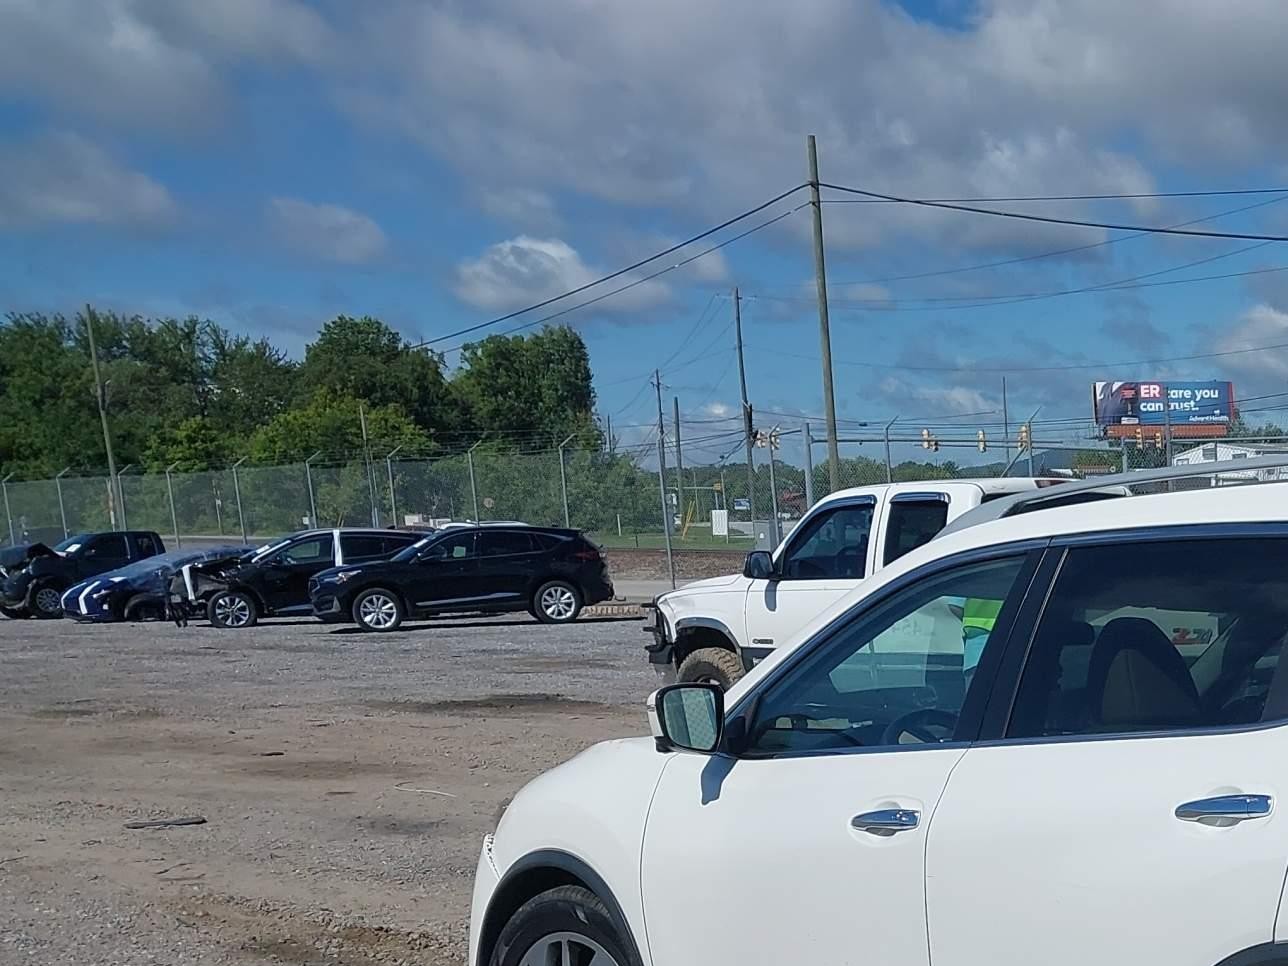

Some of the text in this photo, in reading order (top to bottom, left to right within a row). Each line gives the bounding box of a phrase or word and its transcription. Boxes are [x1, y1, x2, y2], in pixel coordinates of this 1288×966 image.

[1140, 384, 1160, 398] ER
[1194, 389, 1219, 401] you
[1140, 401, 1164, 411] can
